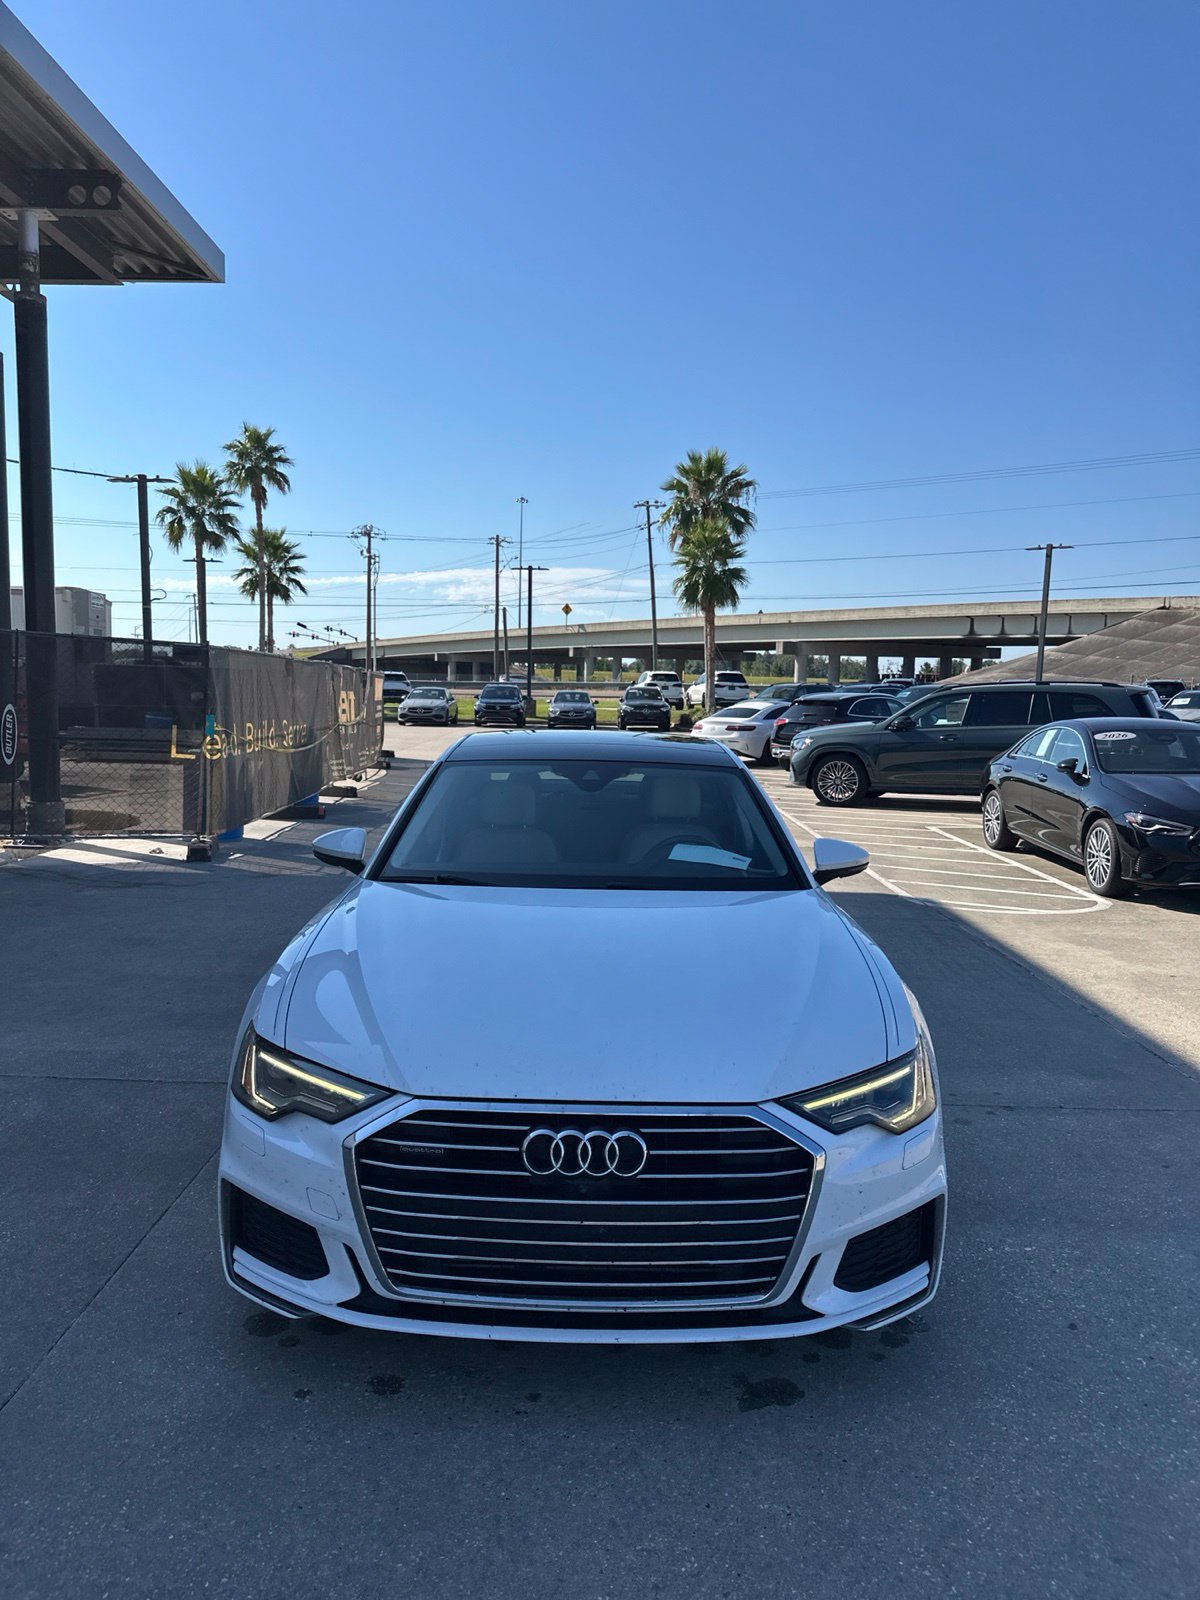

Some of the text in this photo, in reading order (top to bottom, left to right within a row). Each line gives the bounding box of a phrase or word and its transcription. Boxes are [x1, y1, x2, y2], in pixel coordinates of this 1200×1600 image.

[5, 713, 13, 755] BUTLER
[171, 722, 241, 760] Lead.
[245, 719, 279, 753] Build.
